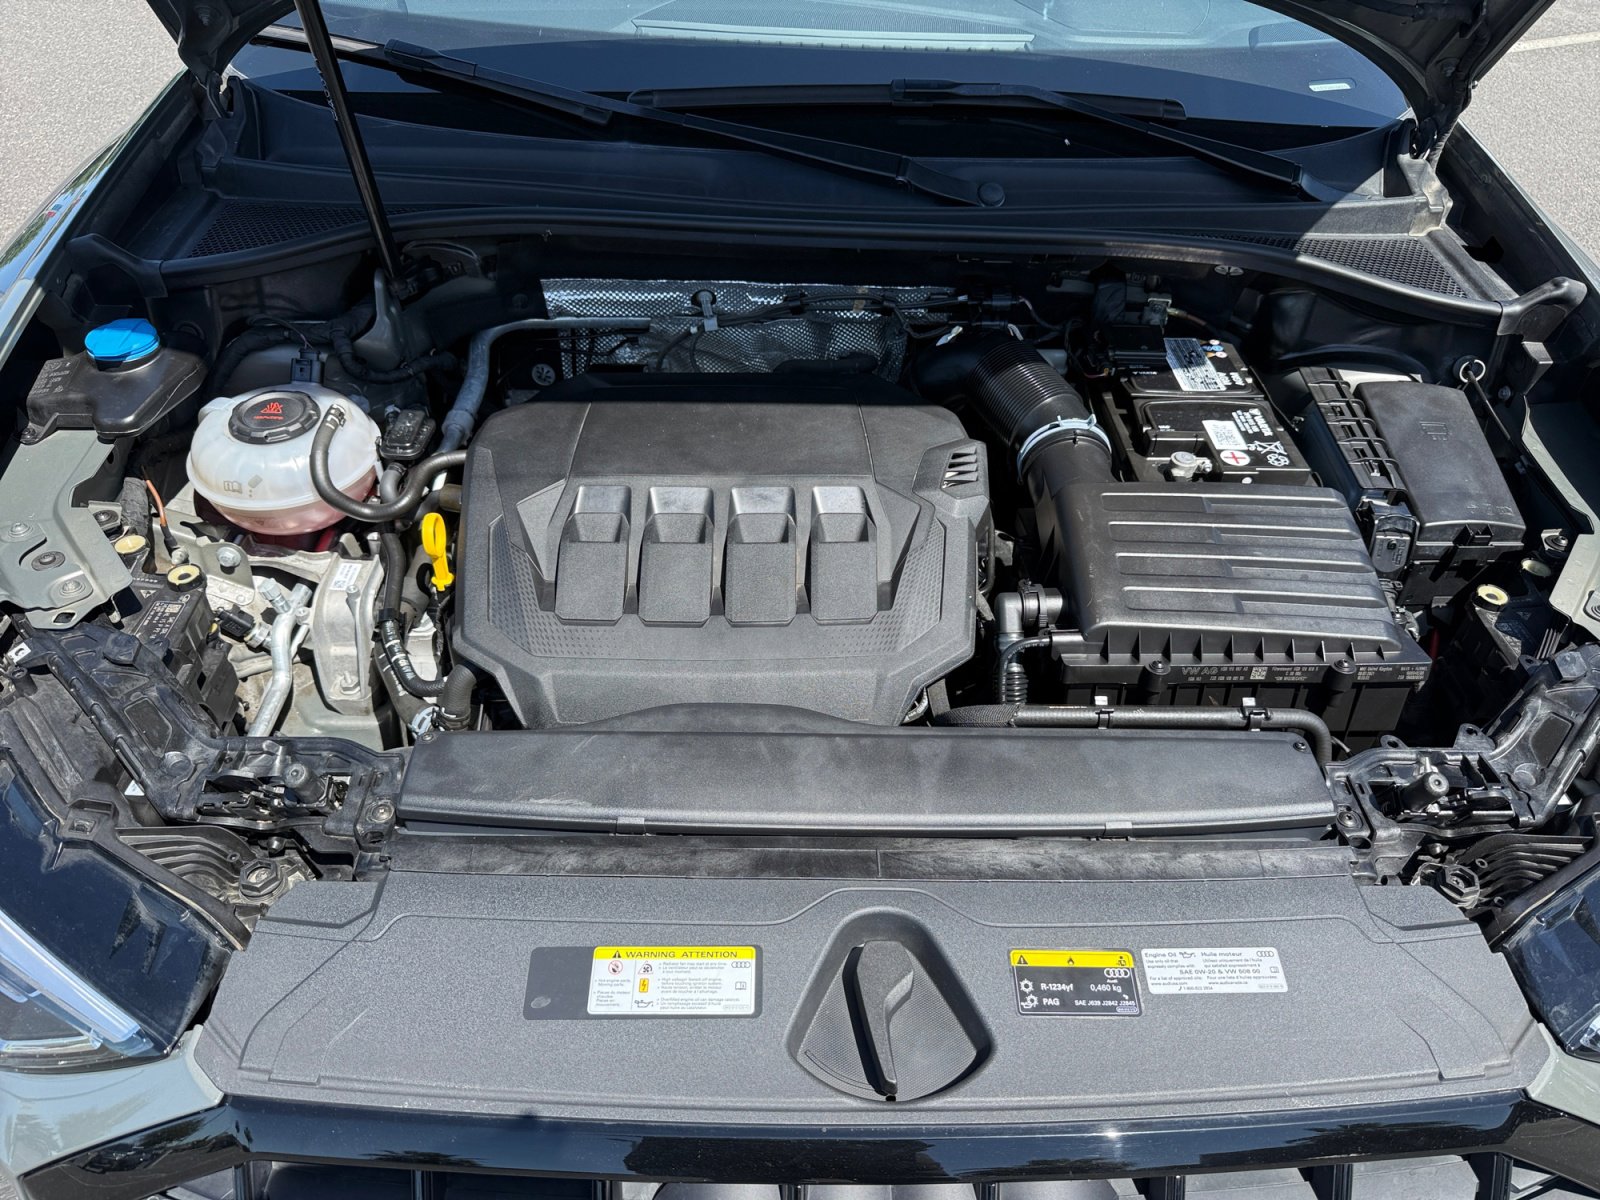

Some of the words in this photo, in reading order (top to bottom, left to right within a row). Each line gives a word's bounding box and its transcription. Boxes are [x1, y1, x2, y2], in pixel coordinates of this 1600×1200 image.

[1041, 983, 1074, 992] R-1234yf
[1112, 984, 1122, 992] kg
[1043, 998, 1060, 1006] PAG
